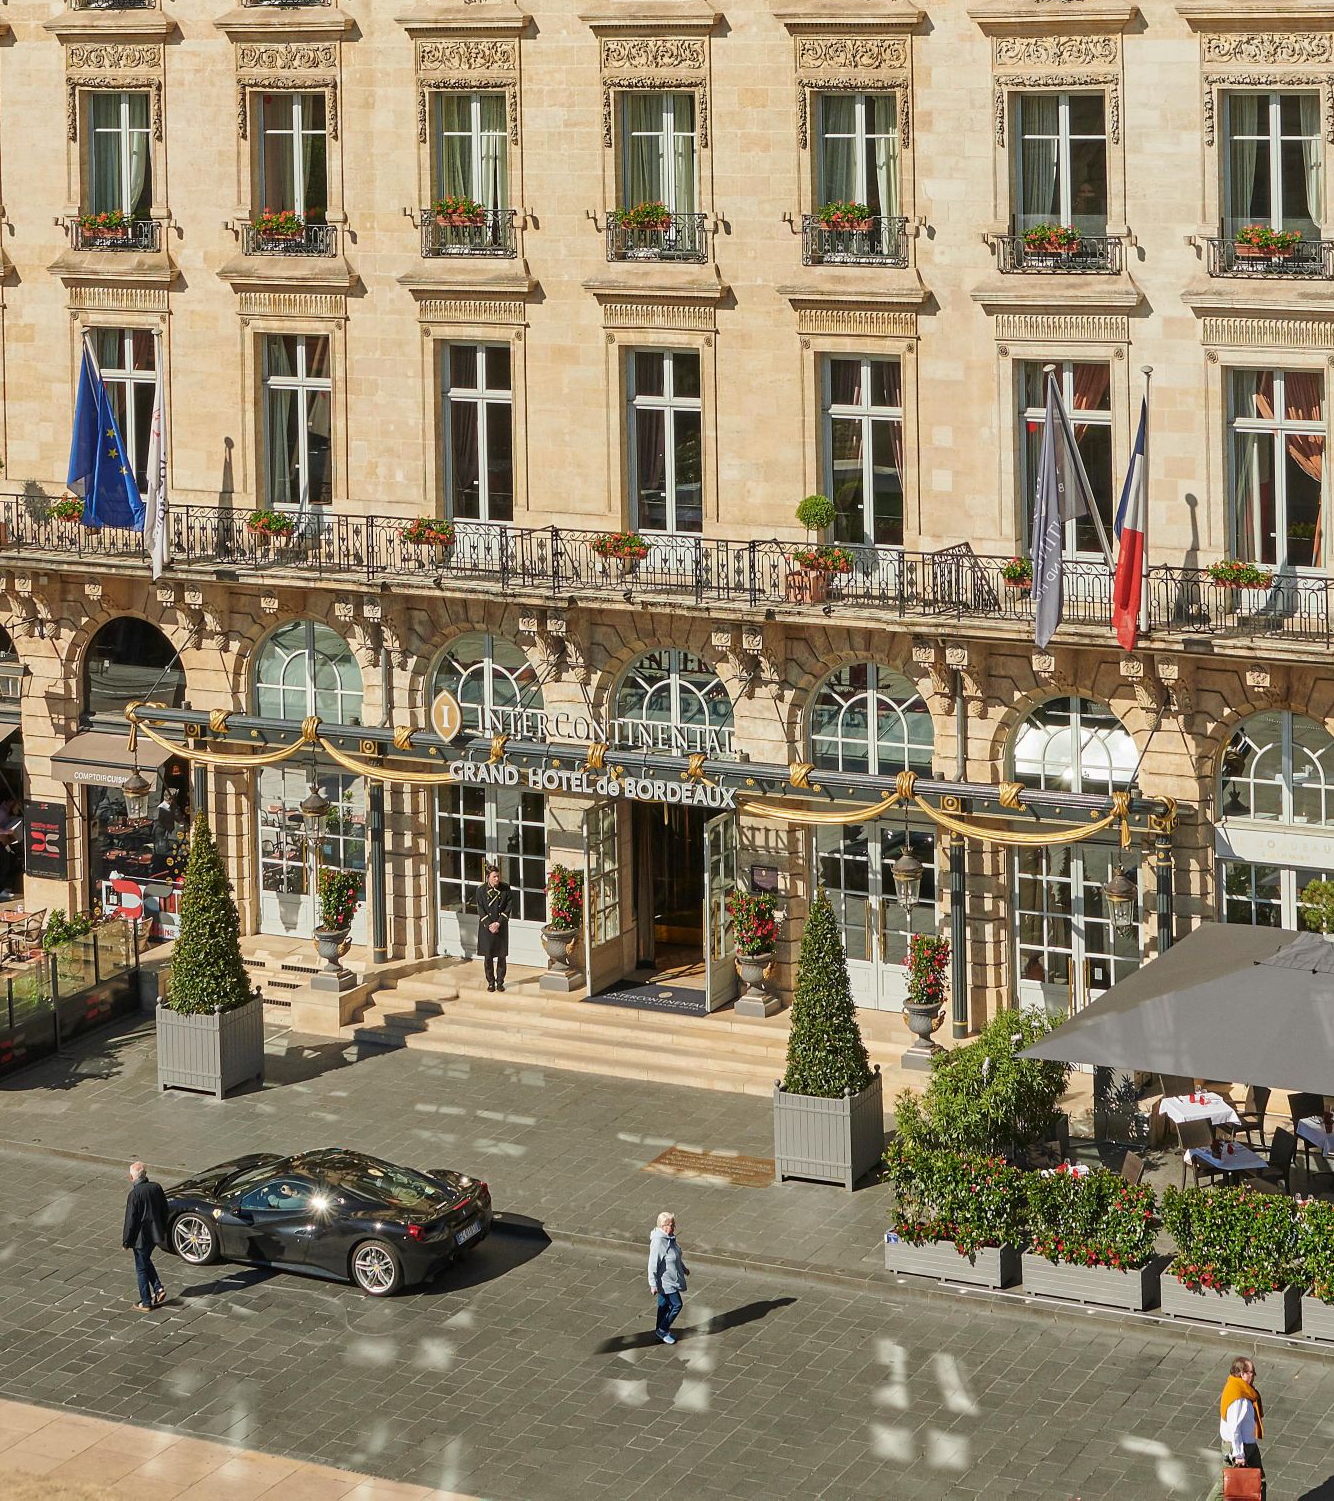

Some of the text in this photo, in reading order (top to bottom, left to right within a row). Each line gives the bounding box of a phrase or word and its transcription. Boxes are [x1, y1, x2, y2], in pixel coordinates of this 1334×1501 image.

[478, 705, 737, 754] INTERCONTINENTAL
[73, 771, 128, 785] COMPTOIRCUISIN
[449, 760, 739, 808] GRAND HOTEL de BORDEAUX
